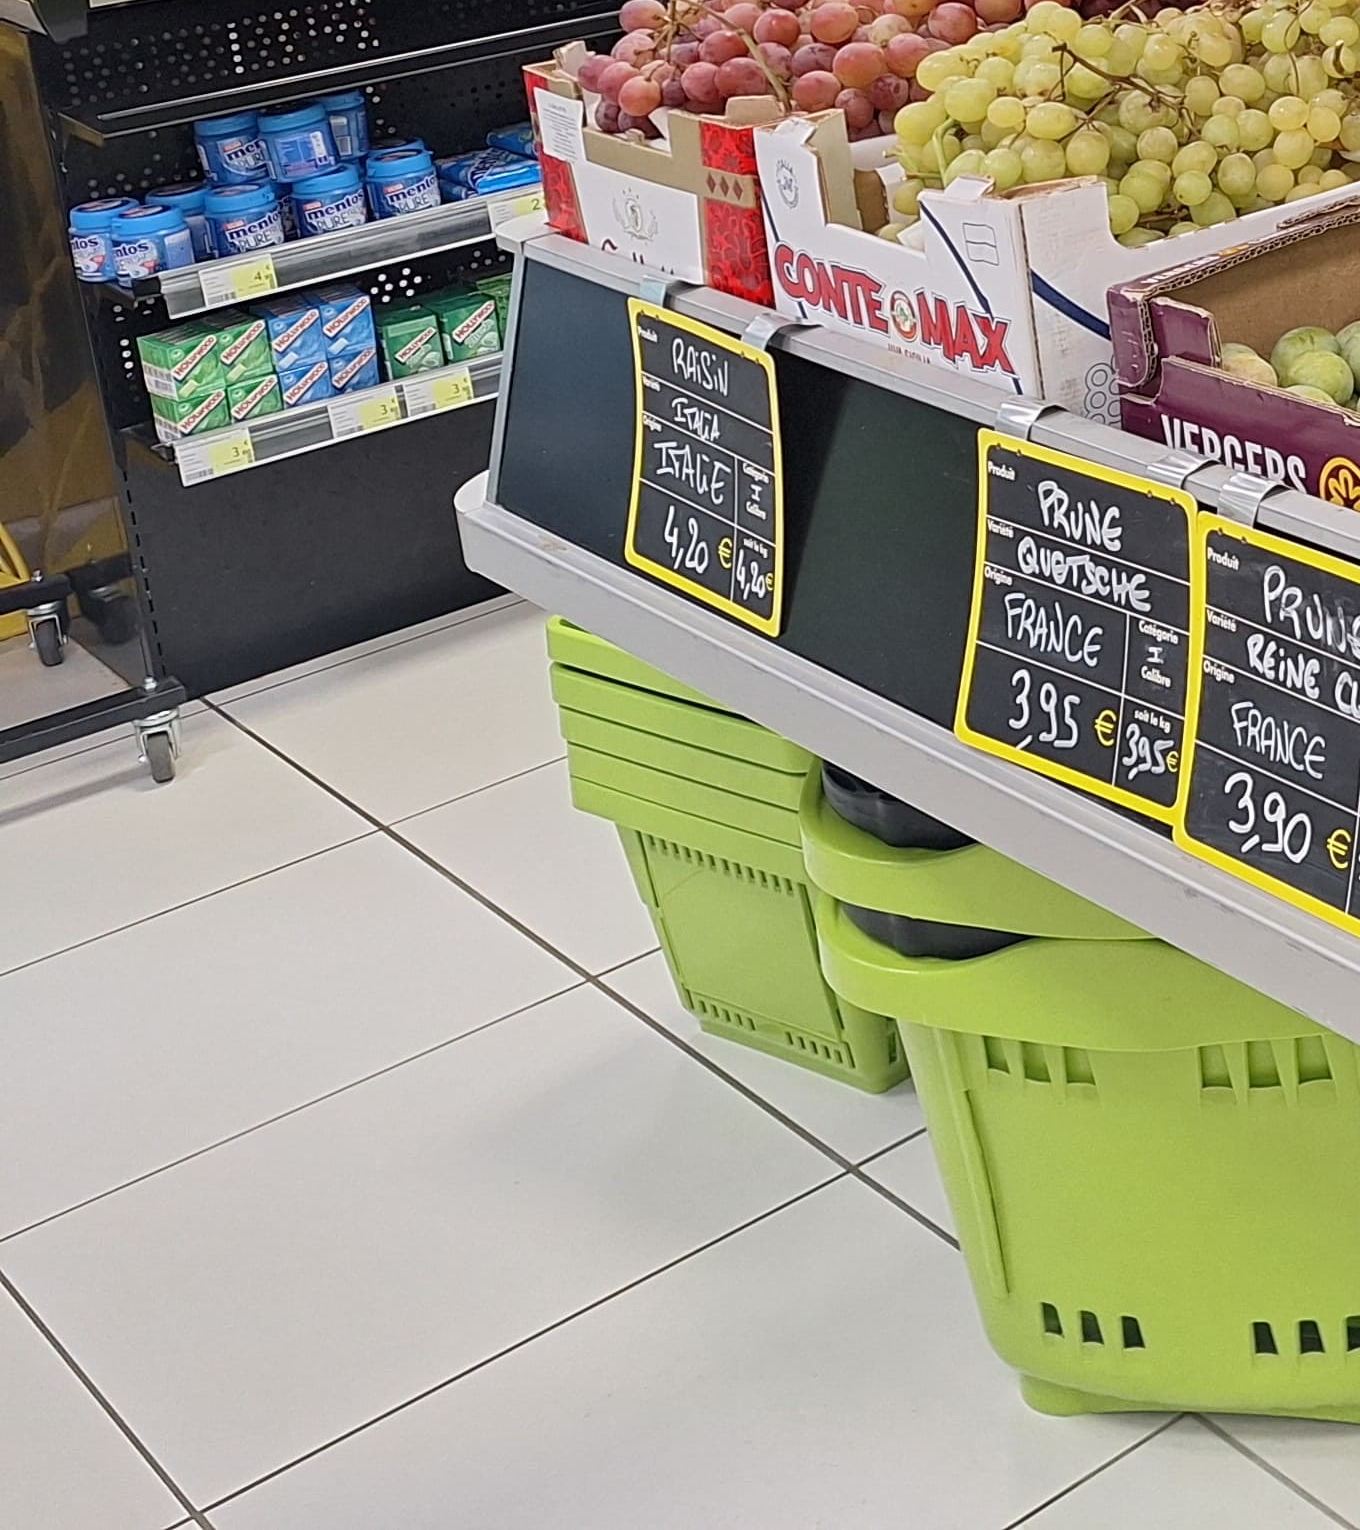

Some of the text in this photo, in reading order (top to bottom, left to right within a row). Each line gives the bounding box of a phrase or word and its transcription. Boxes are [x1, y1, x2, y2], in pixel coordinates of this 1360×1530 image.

[916, 286, 1020, 378] MAX
[987, 460, 1122, 552] Produit PRUNE
[663, 505, 709, 574] 4,20
[717, 537, 733, 570] €
[736, 548, 767, 601] 4,20
[1206, 546, 1240, 571] Produit
[1003, 592, 1104, 667] FRANCE
[1206, 609, 1237, 633] Variété
[1008, 668, 1117, 751] 3,95 €
[1203, 659, 1235, 684] Origine
[1121, 722, 1175, 781] 3,95
[1230, 700, 1327, 780] FRANCE
[1224, 771, 1352, 870] 3,90 €
